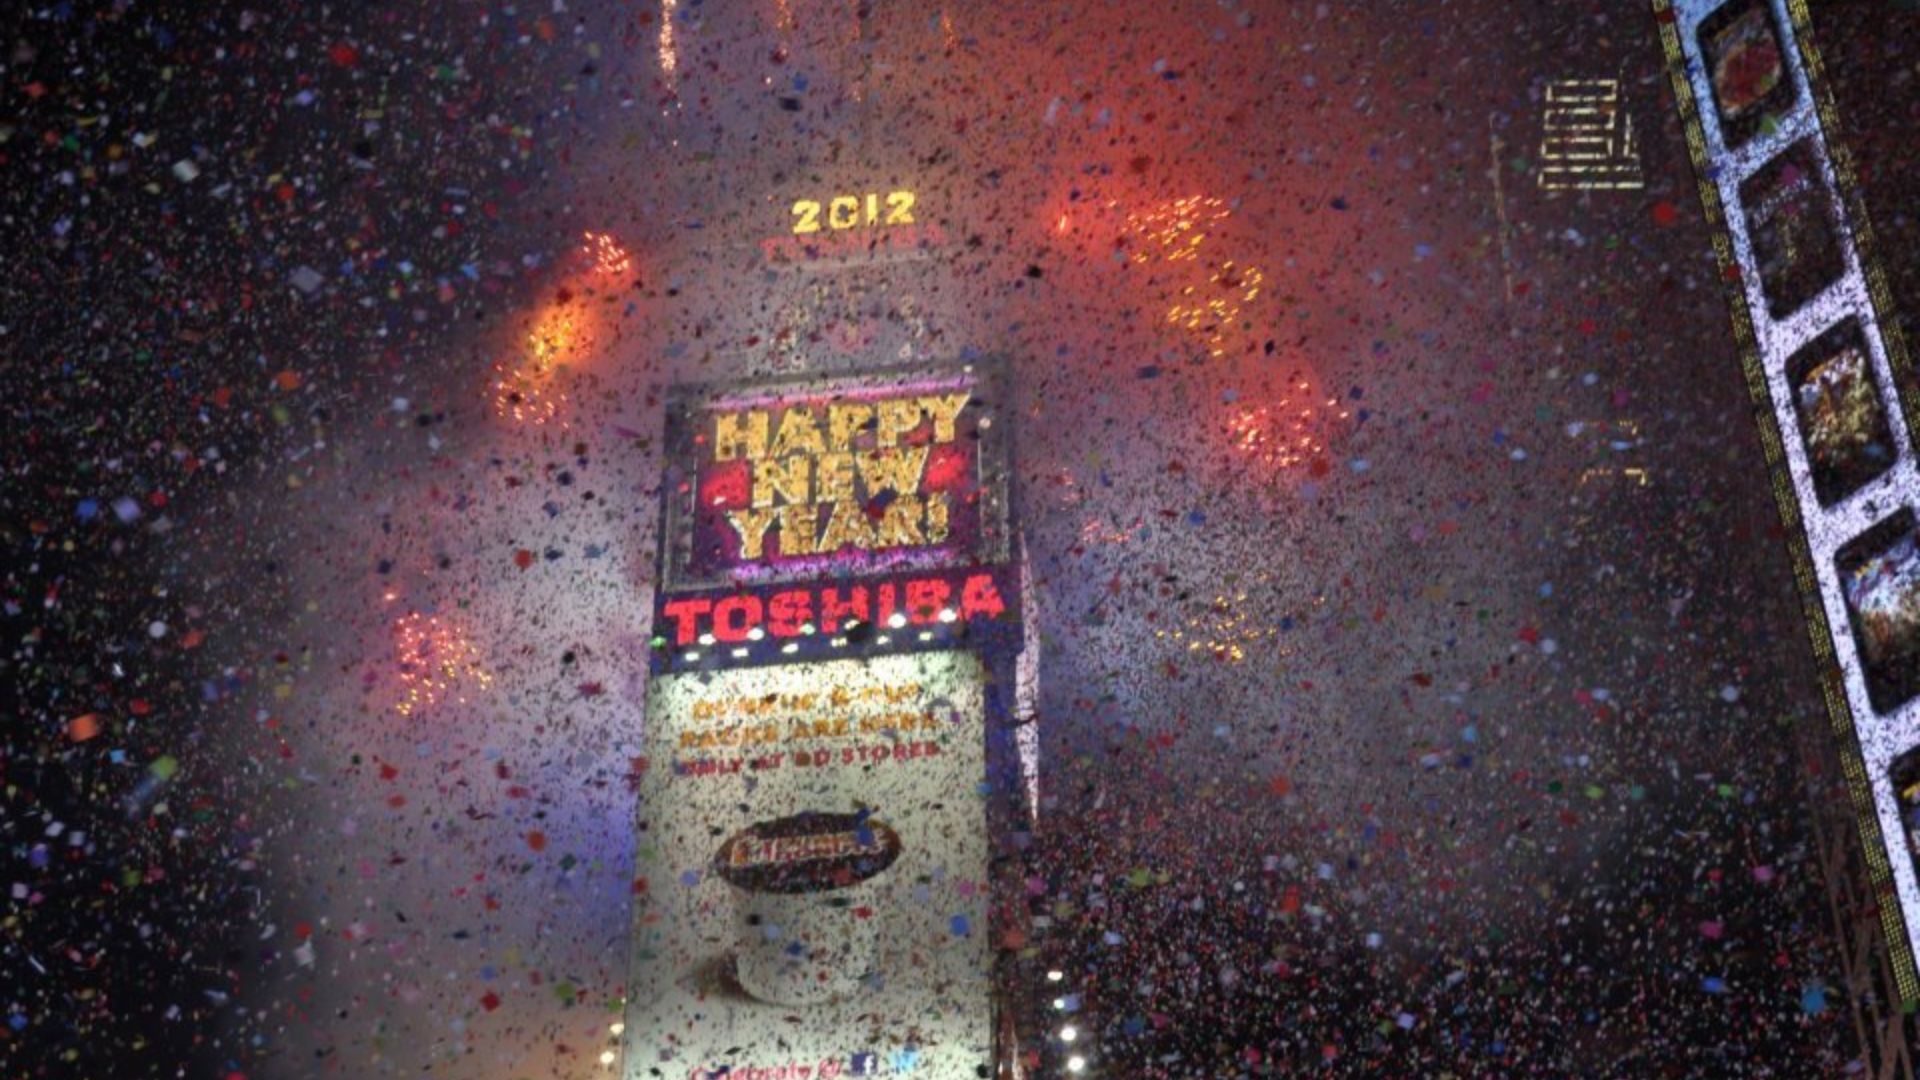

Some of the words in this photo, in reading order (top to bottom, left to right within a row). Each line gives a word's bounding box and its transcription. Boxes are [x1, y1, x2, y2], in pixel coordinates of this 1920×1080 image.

[792, 190, 916, 234] 2012
[715, 391, 971, 461] HAPPY
[753, 446, 930, 508] NEW
[729, 491, 949, 559] YEAR!
[664, 574, 1005, 645] TOSHIBA
[674, 756, 744, 778] NLY
